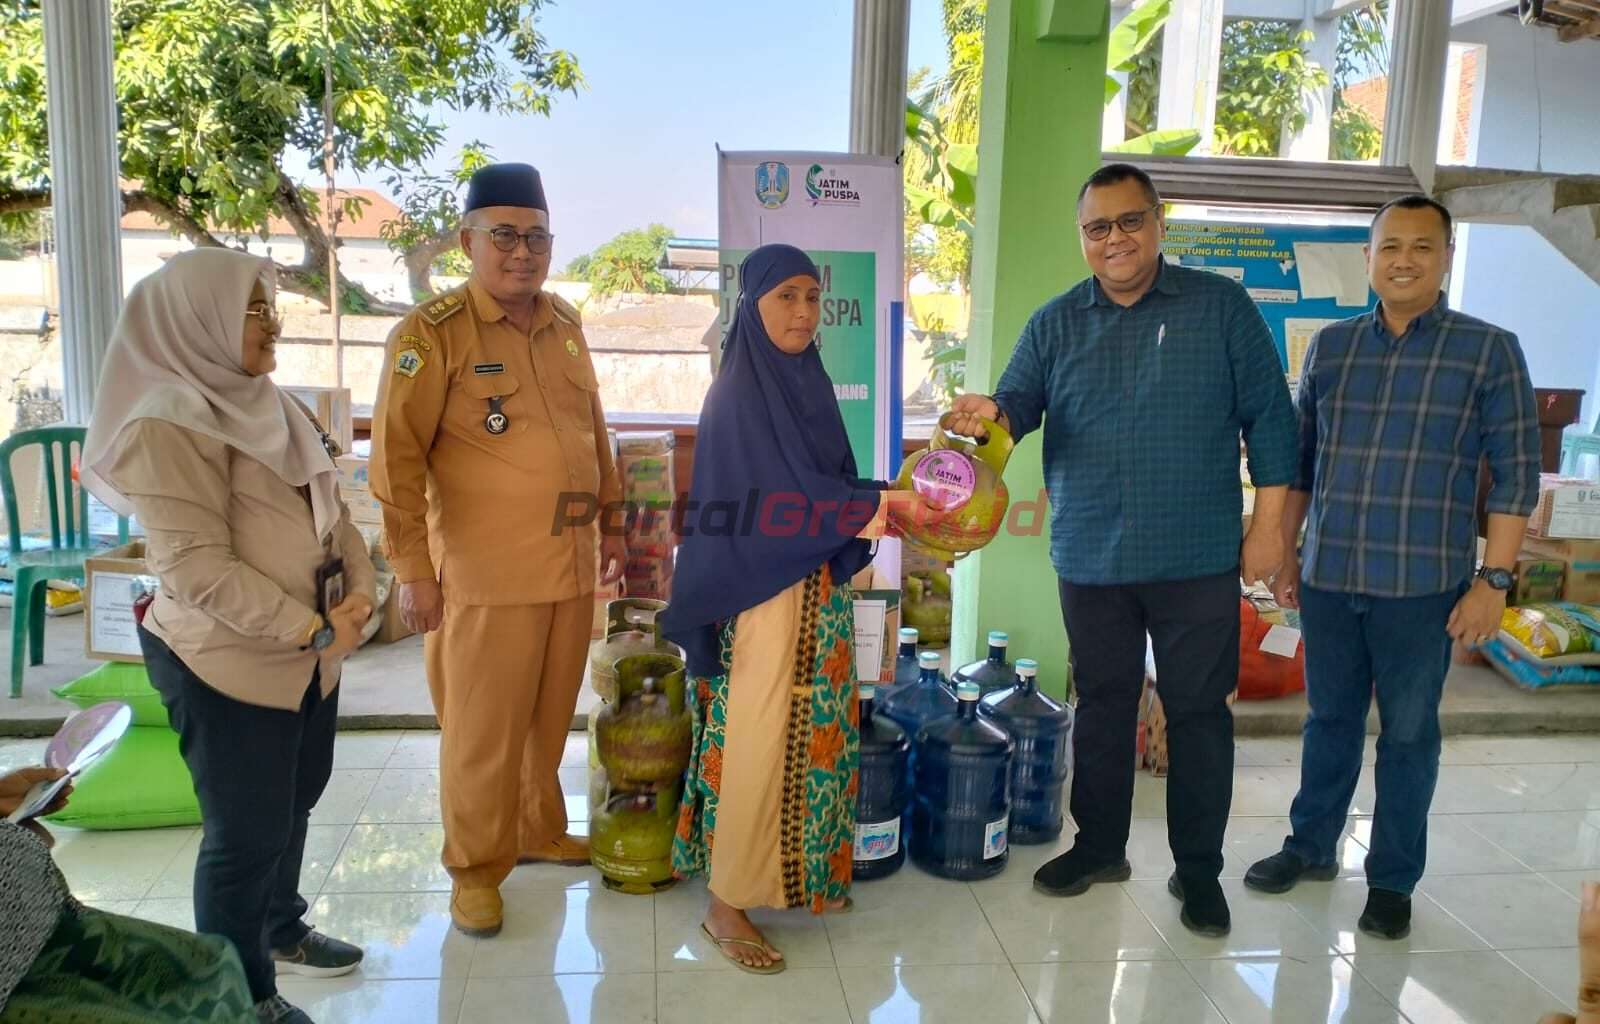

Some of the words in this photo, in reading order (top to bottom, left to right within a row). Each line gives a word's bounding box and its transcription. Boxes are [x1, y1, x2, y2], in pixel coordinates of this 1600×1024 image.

[818, 179, 849, 189] JATIM
[824, 190, 860, 200] PUSPA
[1192, 235, 1236, 245] TANGGUH
[1239, 237, 1276, 247] SEMERU
[1214, 248, 1235, 257] KEC.
[1237, 249, 1269, 258] DUKUN
[820, 299, 863, 327] SPA
[935, 469, 962, 483] JATIM
